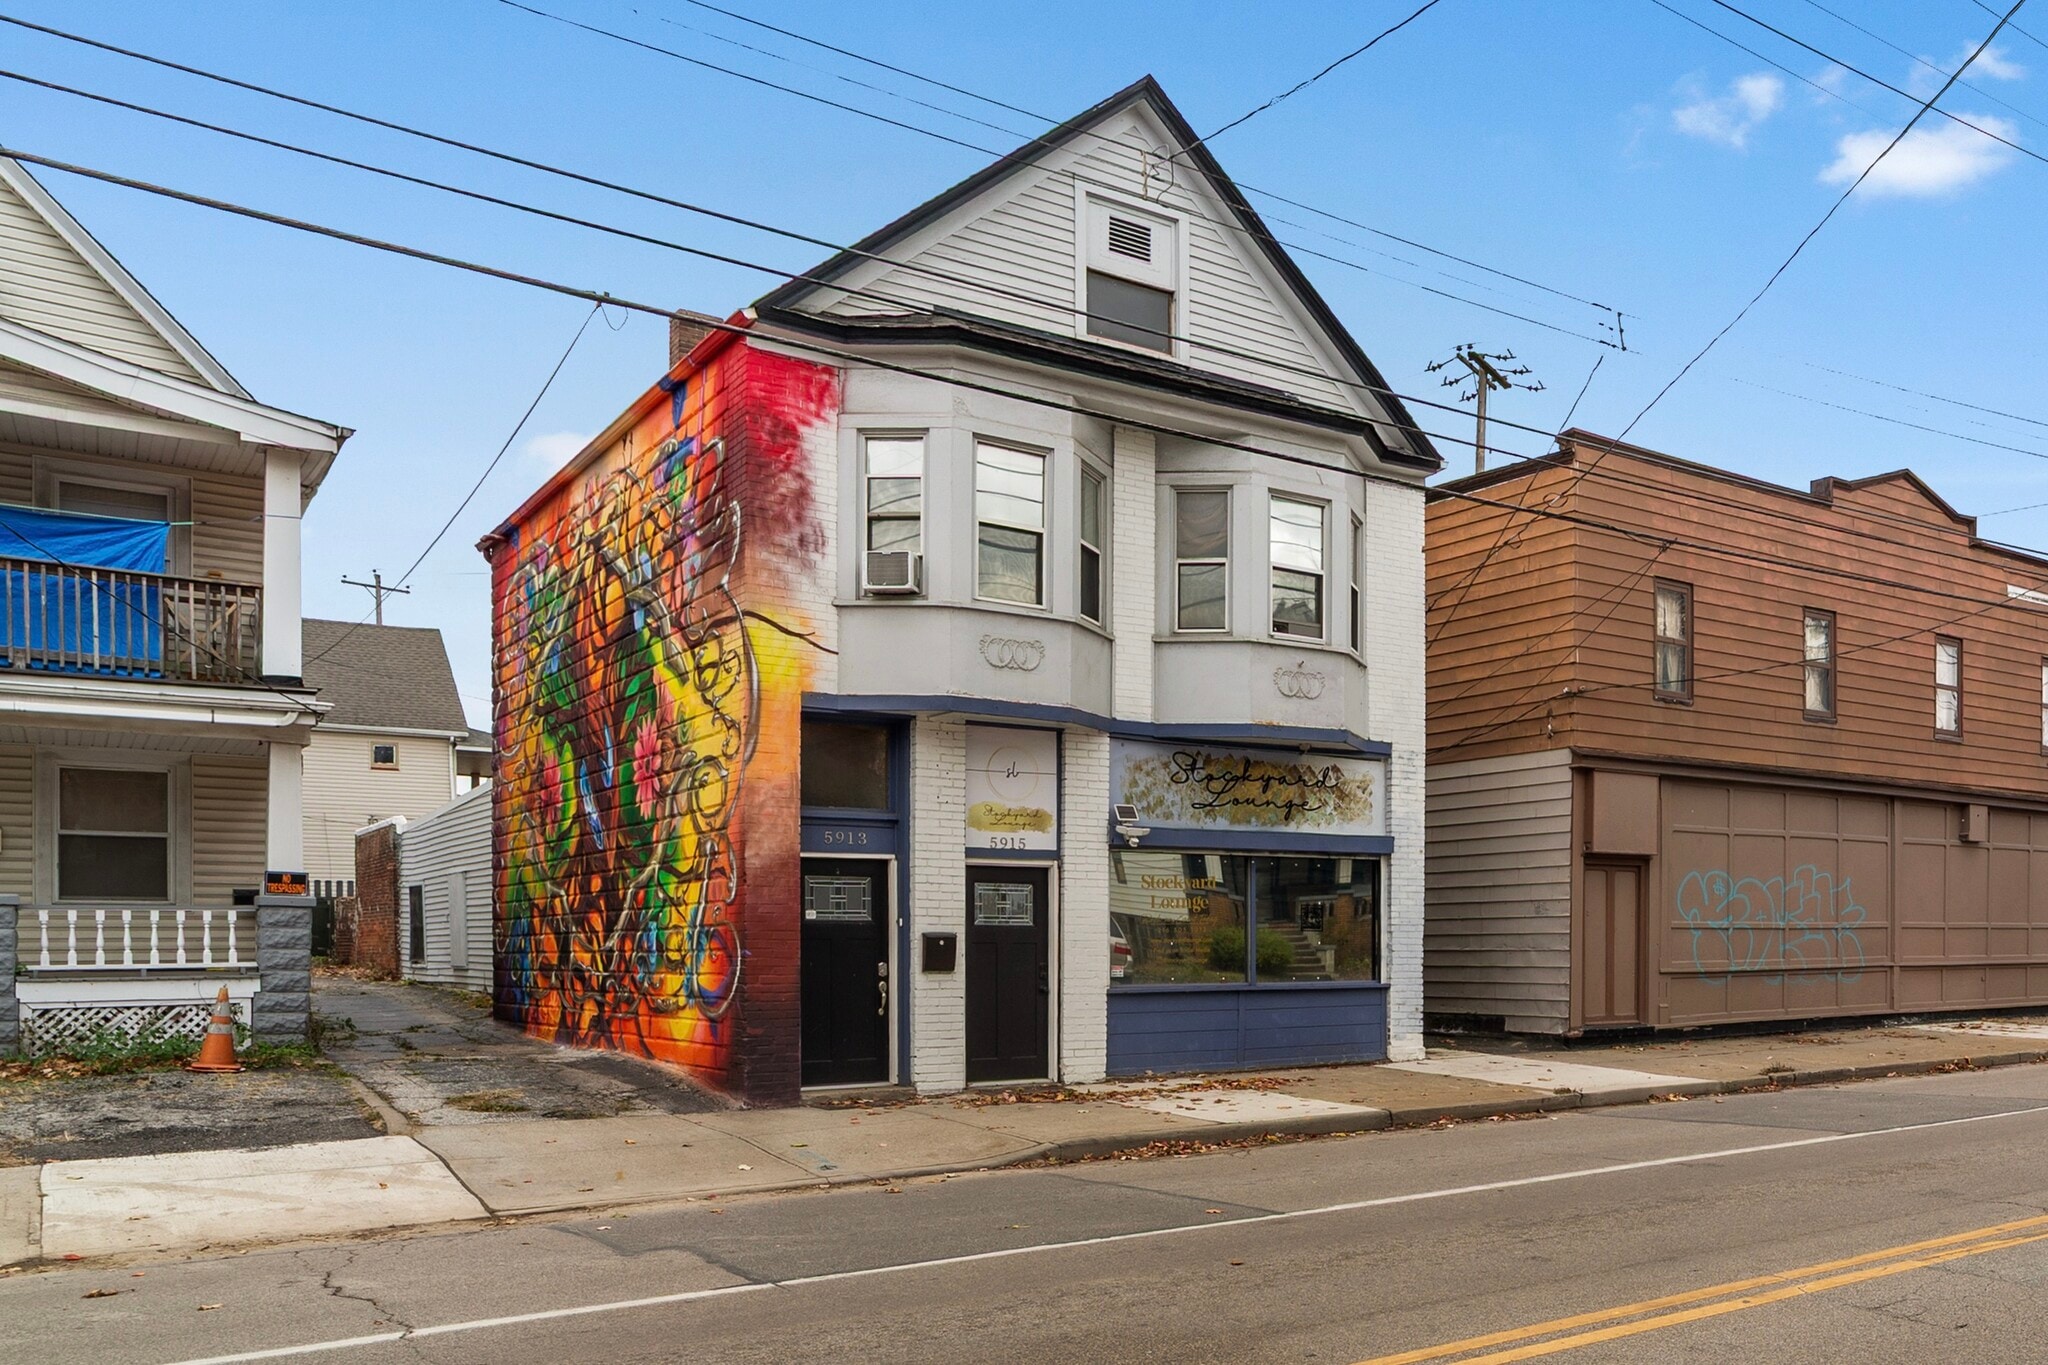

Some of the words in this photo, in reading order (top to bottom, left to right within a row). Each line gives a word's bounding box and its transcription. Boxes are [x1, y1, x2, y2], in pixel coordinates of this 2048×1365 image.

[1171, 751, 1339, 794] Stockyard
[1192, 779, 1321, 821] Lounge
[983, 804, 1043, 821] Stockyard
[990, 814, 1037, 830] Lounge
[824, 831, 867, 845] 5913
[990, 837, 1026, 850] 5915
[282, 874, 291, 883] NO
[1141, 875, 1217, 893] Stockyard
[267, 883, 305, 894] TRESPASSING
[1151, 895, 1209, 913] Lounge
